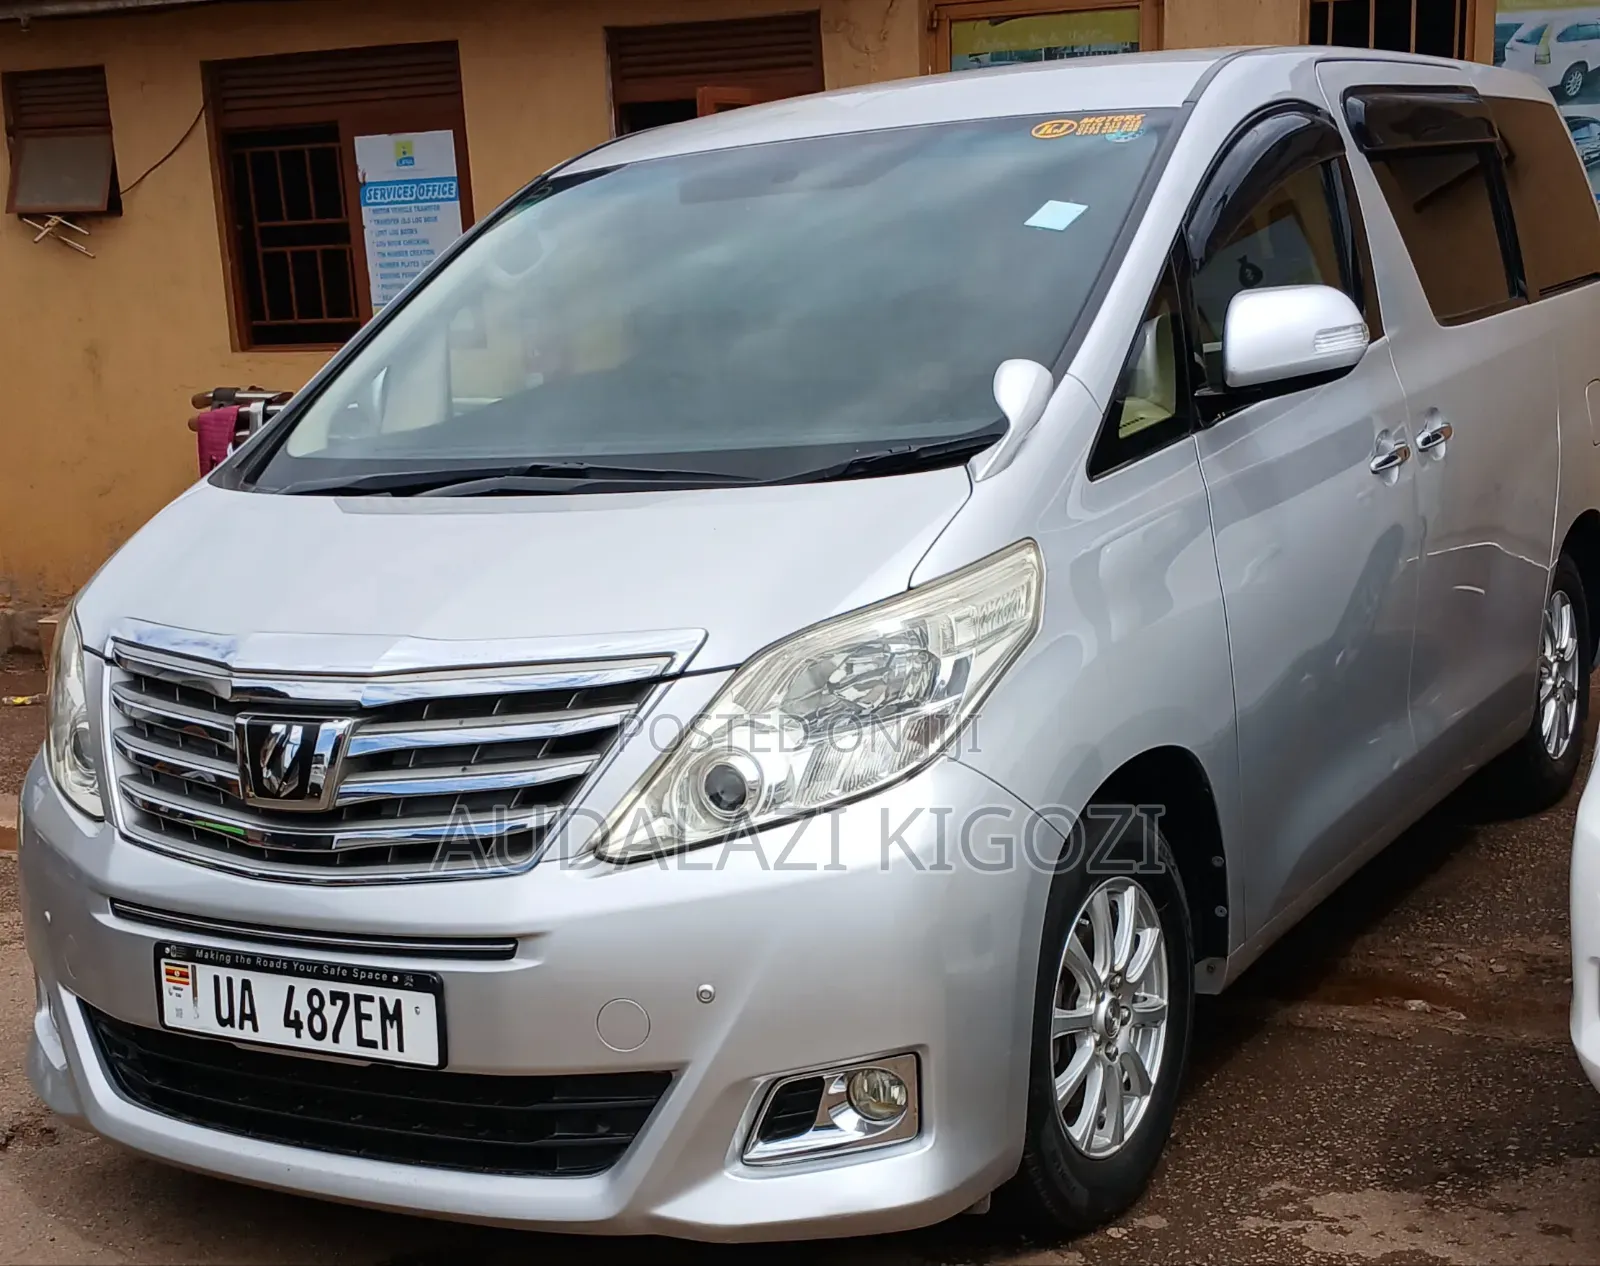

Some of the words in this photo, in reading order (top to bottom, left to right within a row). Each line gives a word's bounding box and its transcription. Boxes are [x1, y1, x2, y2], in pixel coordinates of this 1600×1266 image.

[1079, 114, 1146, 124] MOTORS
[366, 184, 416, 202] SERVICES
[418, 182, 455, 200] OFFICE
[196, 949, 231, 964] Making
[235, 955, 251, 965] the
[256, 957, 287, 969] Roads
[293, 961, 317, 973] Your
[323, 964, 347, 977] Safe
[353, 968, 388, 981] Space
[213, 974, 259, 1033] UA
[283, 985, 405, 1053] 487EM
